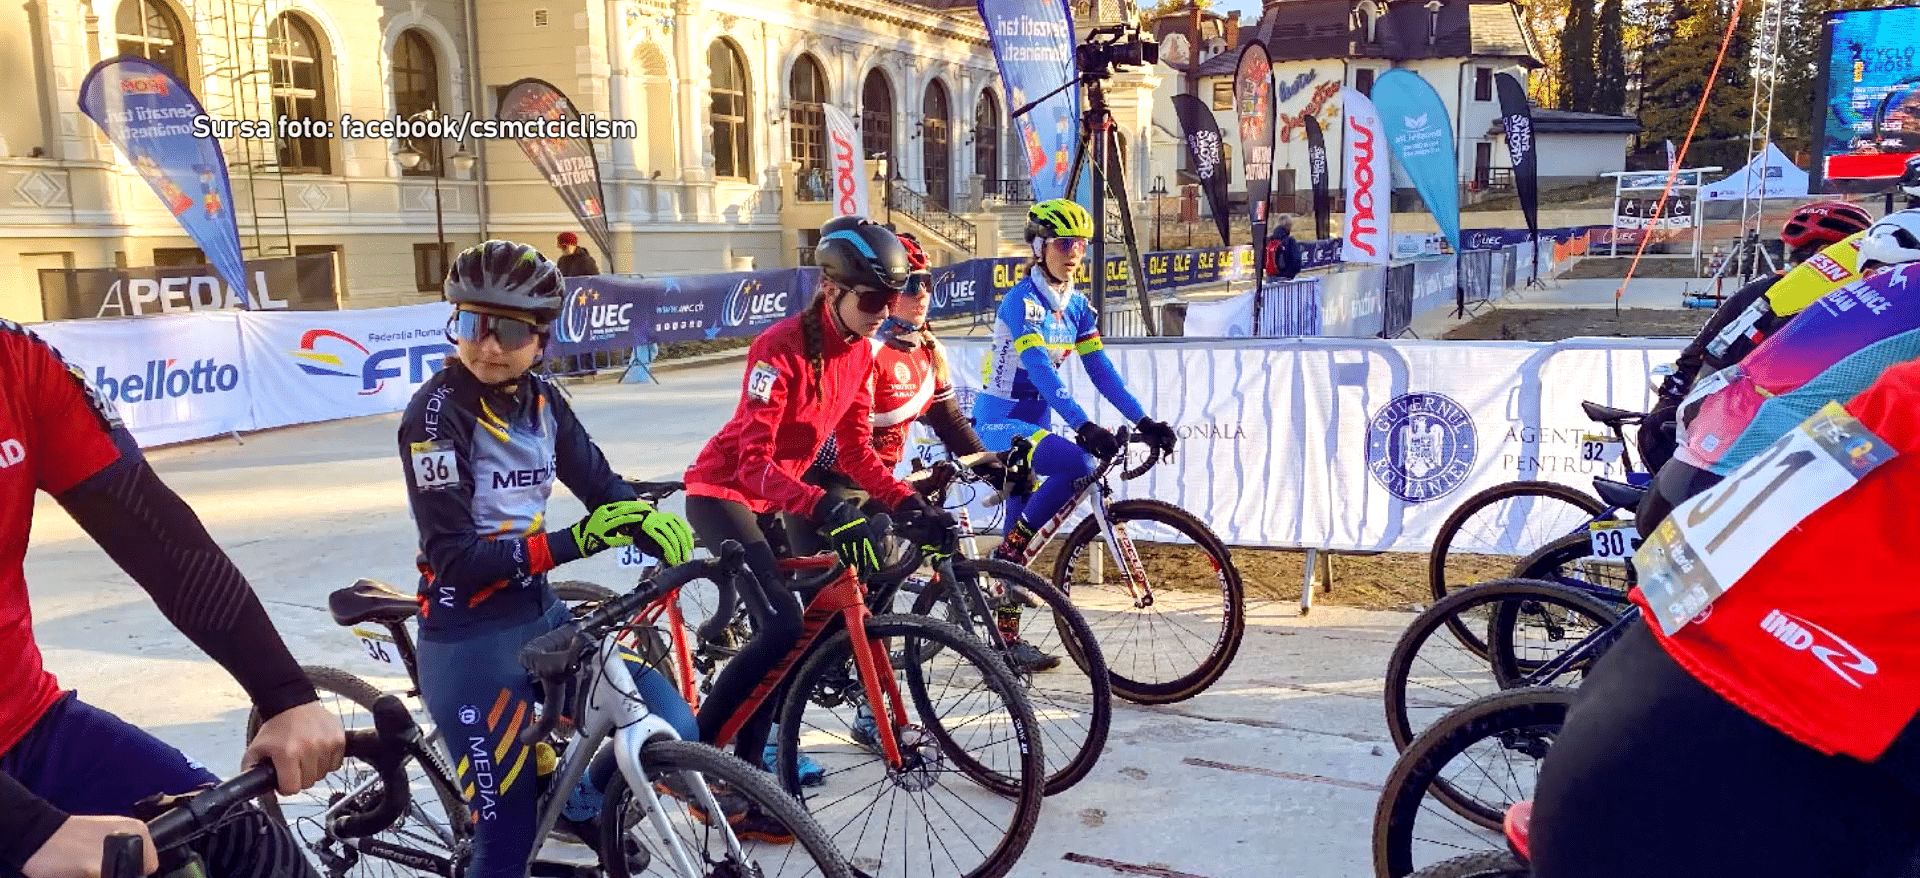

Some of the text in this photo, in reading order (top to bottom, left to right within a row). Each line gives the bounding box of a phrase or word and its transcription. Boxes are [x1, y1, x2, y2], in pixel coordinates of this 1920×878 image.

[950, 280, 977, 299] UEC
[591, 302, 634, 328] UEC
[751, 292, 788, 315] UEC
[96, 357, 239, 404] bellotto
[752, 371, 770, 393] 35
[1584, 442, 1604, 462] 32
[421, 455, 450, 482] 36
[620, 546, 644, 565] 35
[1596, 529, 1625, 558] 30
[361, 637, 391, 664] 36
